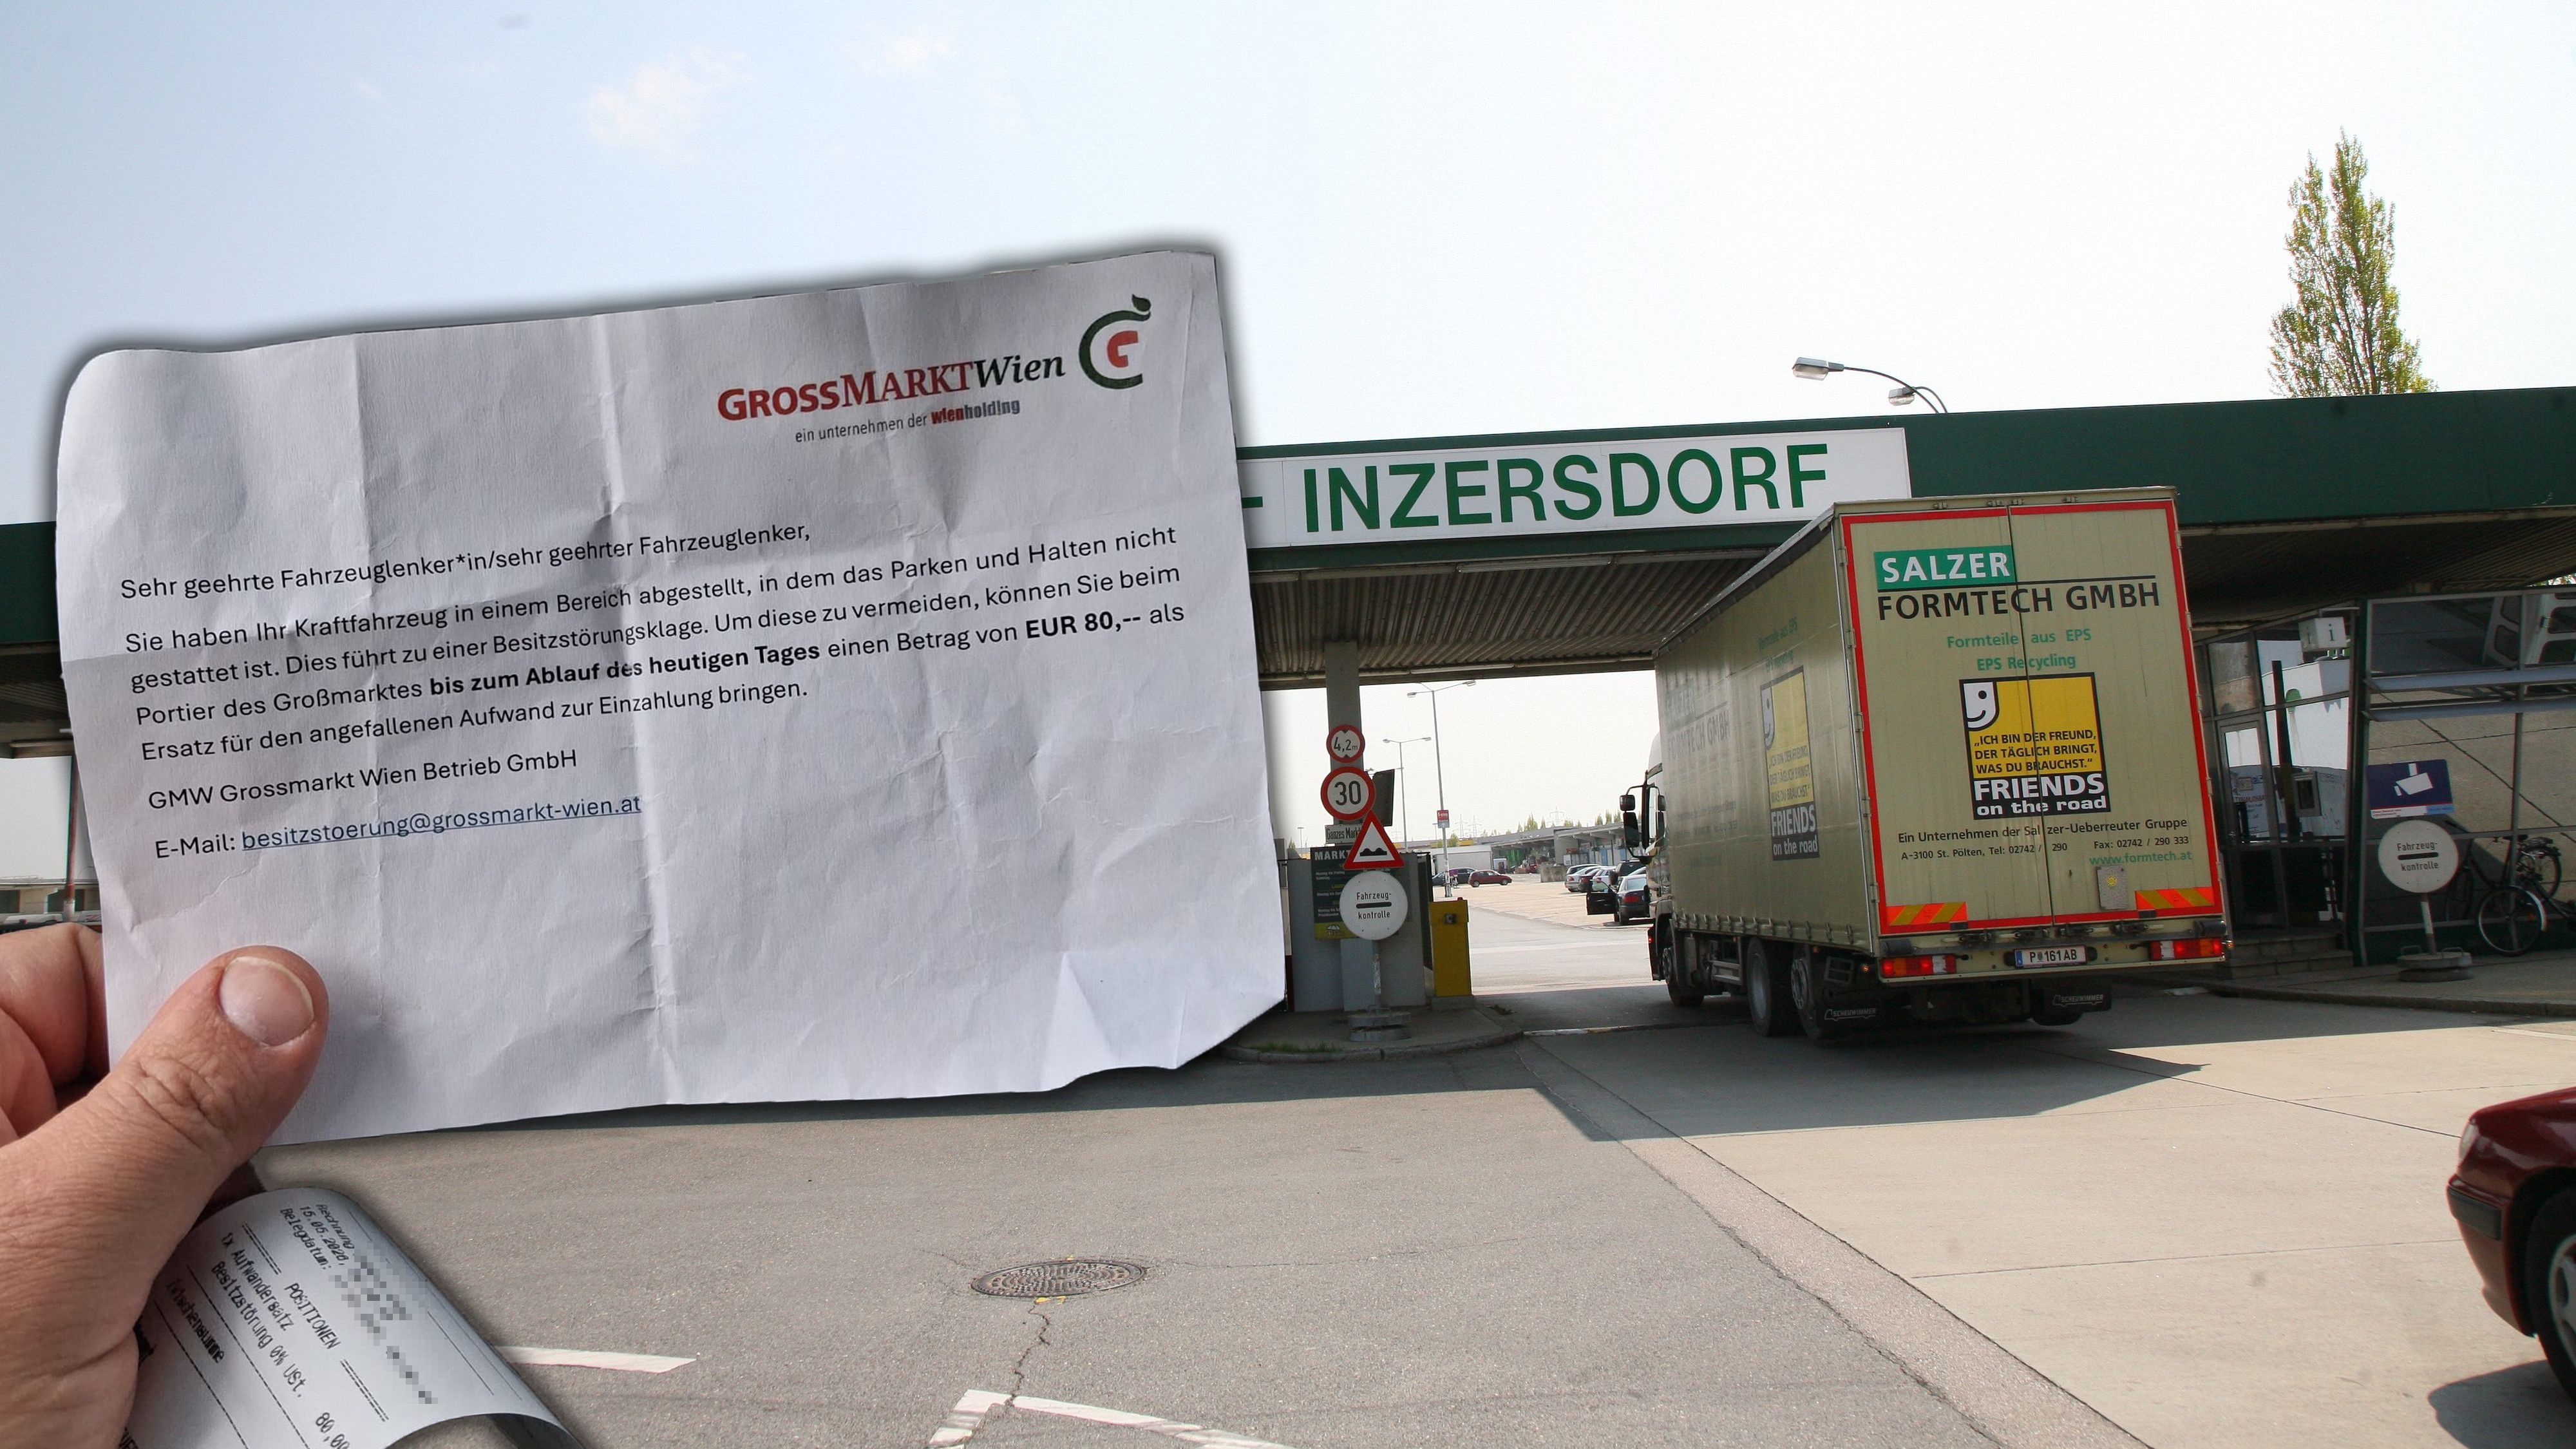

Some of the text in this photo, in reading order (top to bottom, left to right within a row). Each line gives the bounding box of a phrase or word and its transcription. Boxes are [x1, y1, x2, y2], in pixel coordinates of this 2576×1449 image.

[796, 429, 814, 442] ein
[819, 419, 904, 440] unternehmen
[908, 414, 927, 428] der
[1303, 443, 1828, 533] INZERSDORF
[121, 578, 177, 598] Sehr
[185, 574, 274, 598] geehrte
[549, 541, 633, 567] geehrter
[640, 524, 810, 555] Fahrzeuglenker,
[1881, 552, 2010, 583] SALZER
[126, 527, 1177, 652] Sie haben Ihr Kraftfahrzeug in einem Bereich abgestellt, in dem das Parken und Halten nicht
[1878, 582, 2160, 621] FORMTECH GMBH
[131, 566, 1179, 694] gestattet ist. Dies führt zu einer Besitzstörungsklage. Um diese zu vermeiden, können Sie beim
[1947, 629, 2092, 649] Formteile aus EPS
[137, 703, 215, 725] Portier
[224, 699, 266, 717] des
[274, 684, 422, 711] Großmarktes
[430, 677, 464, 695] bis
[471, 674, 518, 691] zum
[526, 663, 600, 685] Ablauf
[607, 661, 642, 678] des
[649, 652, 748, 674] heutigen
[754, 645, 820, 666] Tages
[828, 639, 889, 657] einen
[897, 630, 971, 650] Betrag
[976, 627, 1017, 643] von
[1026, 616, 1077, 639] EUR
[1150, 603, 1184, 623] als
[1977, 658, 2002, 671] EPS
[142, 683, 807, 760] Ersatz für den angefallenen Aufwand zur Einzahlung bringen.
[2002, 734, 2021, 744] BIN
[2024, 732, 2047, 743] DER
[2049, 729, 2096, 741] FREUND,
[1975, 743, 2098, 760] DER TÄGLICH BRINGT,
[149, 749, 576, 809] GMW Grossmarkt Wien Betrieb GmbH
[1976, 763, 2002, 774] WAS
[2006, 762, 2022, 772] DU
[1334, 781, 1361, 806] 30
[1973, 773, 2105, 801] FRIENDS
[1976, 795, 2107, 816] on the road
[155, 796, 641, 858] E-Mail: besitzstoerung@grossmarkt-wien.at
[1771, 804, 1816, 837] FRIENDS
[1898, 832, 1915, 843] Ein
[1918, 829, 1998, 842] Unternehmen
[2002, 826, 2020, 837] der
[2145, 819, 2187, 831] Gruppe
[1773, 835, 1817, 855] on the road
[1901, 850, 1933, 860] A-3100
[1937, 849, 1949, 858] St.
[1953, 848, 1985, 857] Pölten,
[1989, 846, 2005, 855] Tel:
[2009, 844, 2035, 854] 02742
[2052, 842, 2067, 851] 290
[2094, 841, 2114, 849] Fax:
[2117, 838, 2143, 848] 02742
[2155, 837, 2170, 846] 290
[2174, 836, 2189, 845] 333
[2089, 851, 2192, 866] www.formtech.at
[2397, 842, 2438, 851] Fahrzeug-
[2401, 861, 2439, 871] kontrolle
[1356, 892, 1392, 900] Fahrzeug-
[1358, 911, 1390, 920] kontrolle
[2030, 952, 2036, 962] P
[280, 1208, 332, 1269] Belegdatum:
[222, 1232, 295, 1331] 1x Aufwandersatz
[211, 1261, 273, 1349] Besitzstörung
[285, 1283, 342, 1350] POSITIONEN
